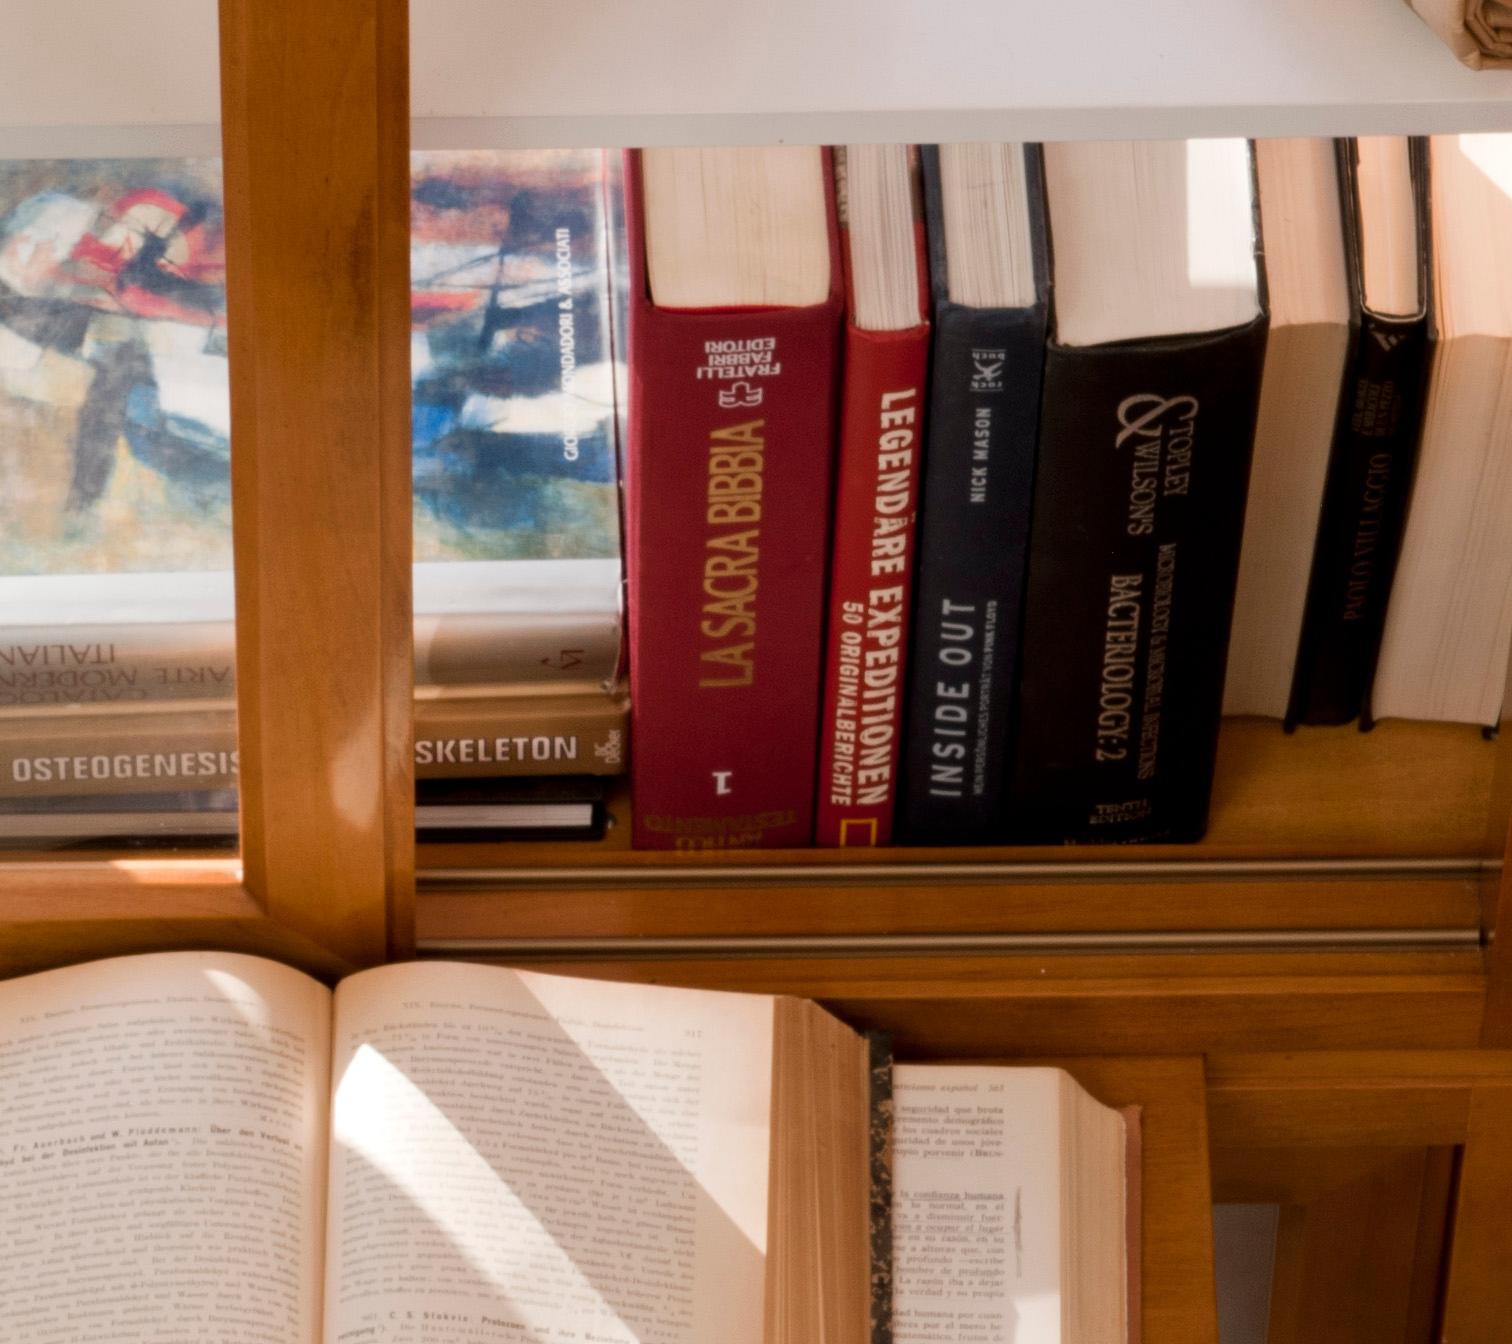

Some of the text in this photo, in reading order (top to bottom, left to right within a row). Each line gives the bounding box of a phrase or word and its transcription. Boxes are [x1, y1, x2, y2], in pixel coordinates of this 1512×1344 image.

[557, 227, 571, 296] ASSOCIATI
[695, 363, 783, 380] FRATELLI
[703, 338, 776, 353] EDITORI
[707, 351, 774, 366] FABBRI
[970, 406, 992, 503] NICK MASON
[1115, 393, 1201, 537] & WILSON'S
[1163, 420, 1195, 497] TOPLEY
[1354, 453, 1393, 563] VILLAGGIO
[697, 418, 766, 689] LA SACRA BIBBIA
[856, 387, 917, 808] LEGENDÄRE EXPEDITIONEN
[1343, 563, 1371, 621] PAOLO
[829, 600, 865, 808] 50 ORIGINALBERICHTE
[929, 598, 976, 798] INSIDE OUT
[12, 751, 241, 783] OSTEOGENESIS
[414, 735, 578, 765] SKELETON
[711, 771, 734, 796] 1
[1095, 746, 1128, 763] 2
